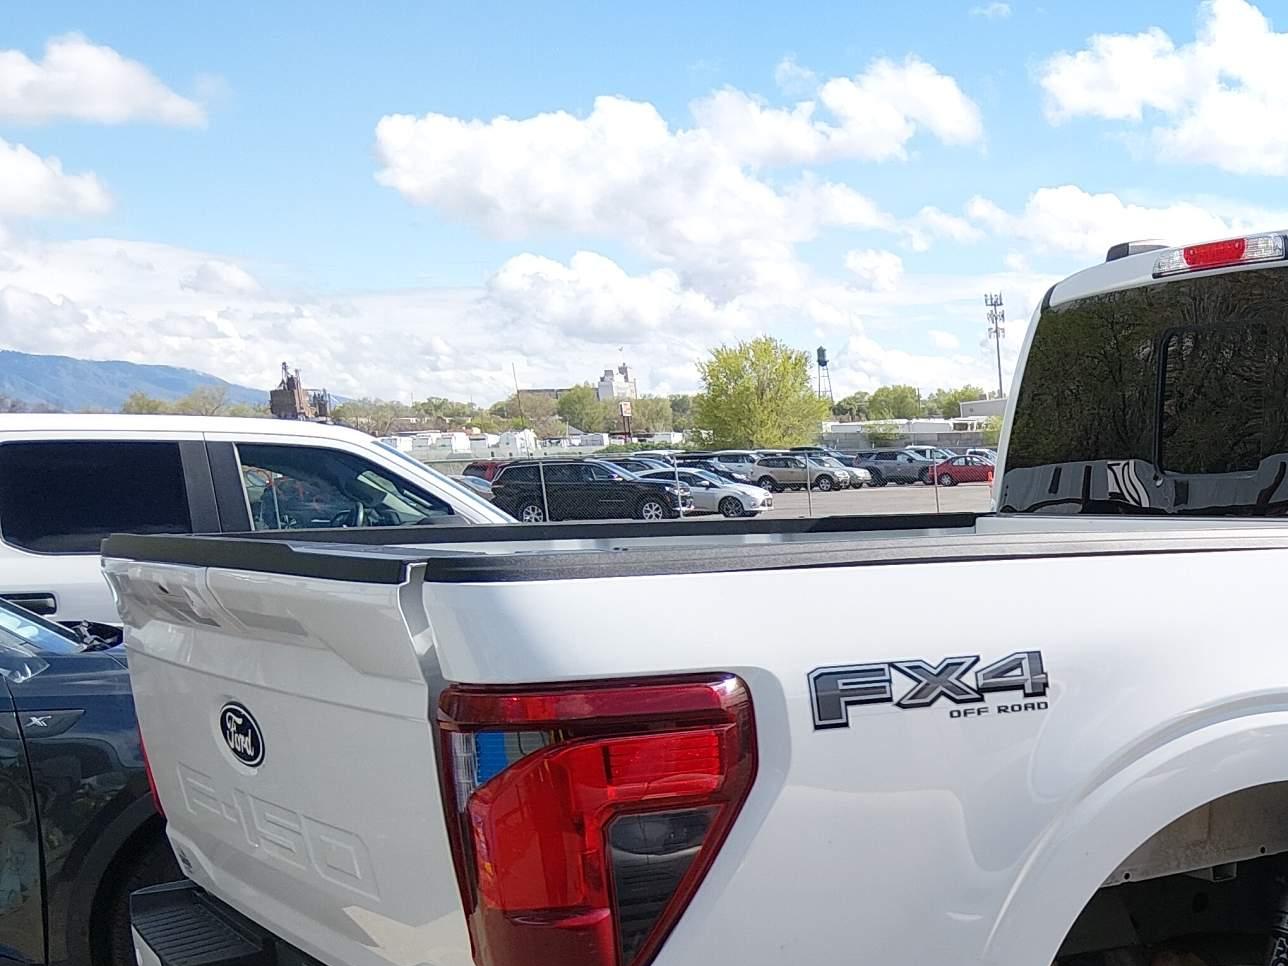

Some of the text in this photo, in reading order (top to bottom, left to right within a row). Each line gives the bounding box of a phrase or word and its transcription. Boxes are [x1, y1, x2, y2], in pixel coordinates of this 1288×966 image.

[807, 650, 1050, 730] FX4
[949, 701, 1048, 719] OFF ROAD
[225, 711, 255, 756] Ford
